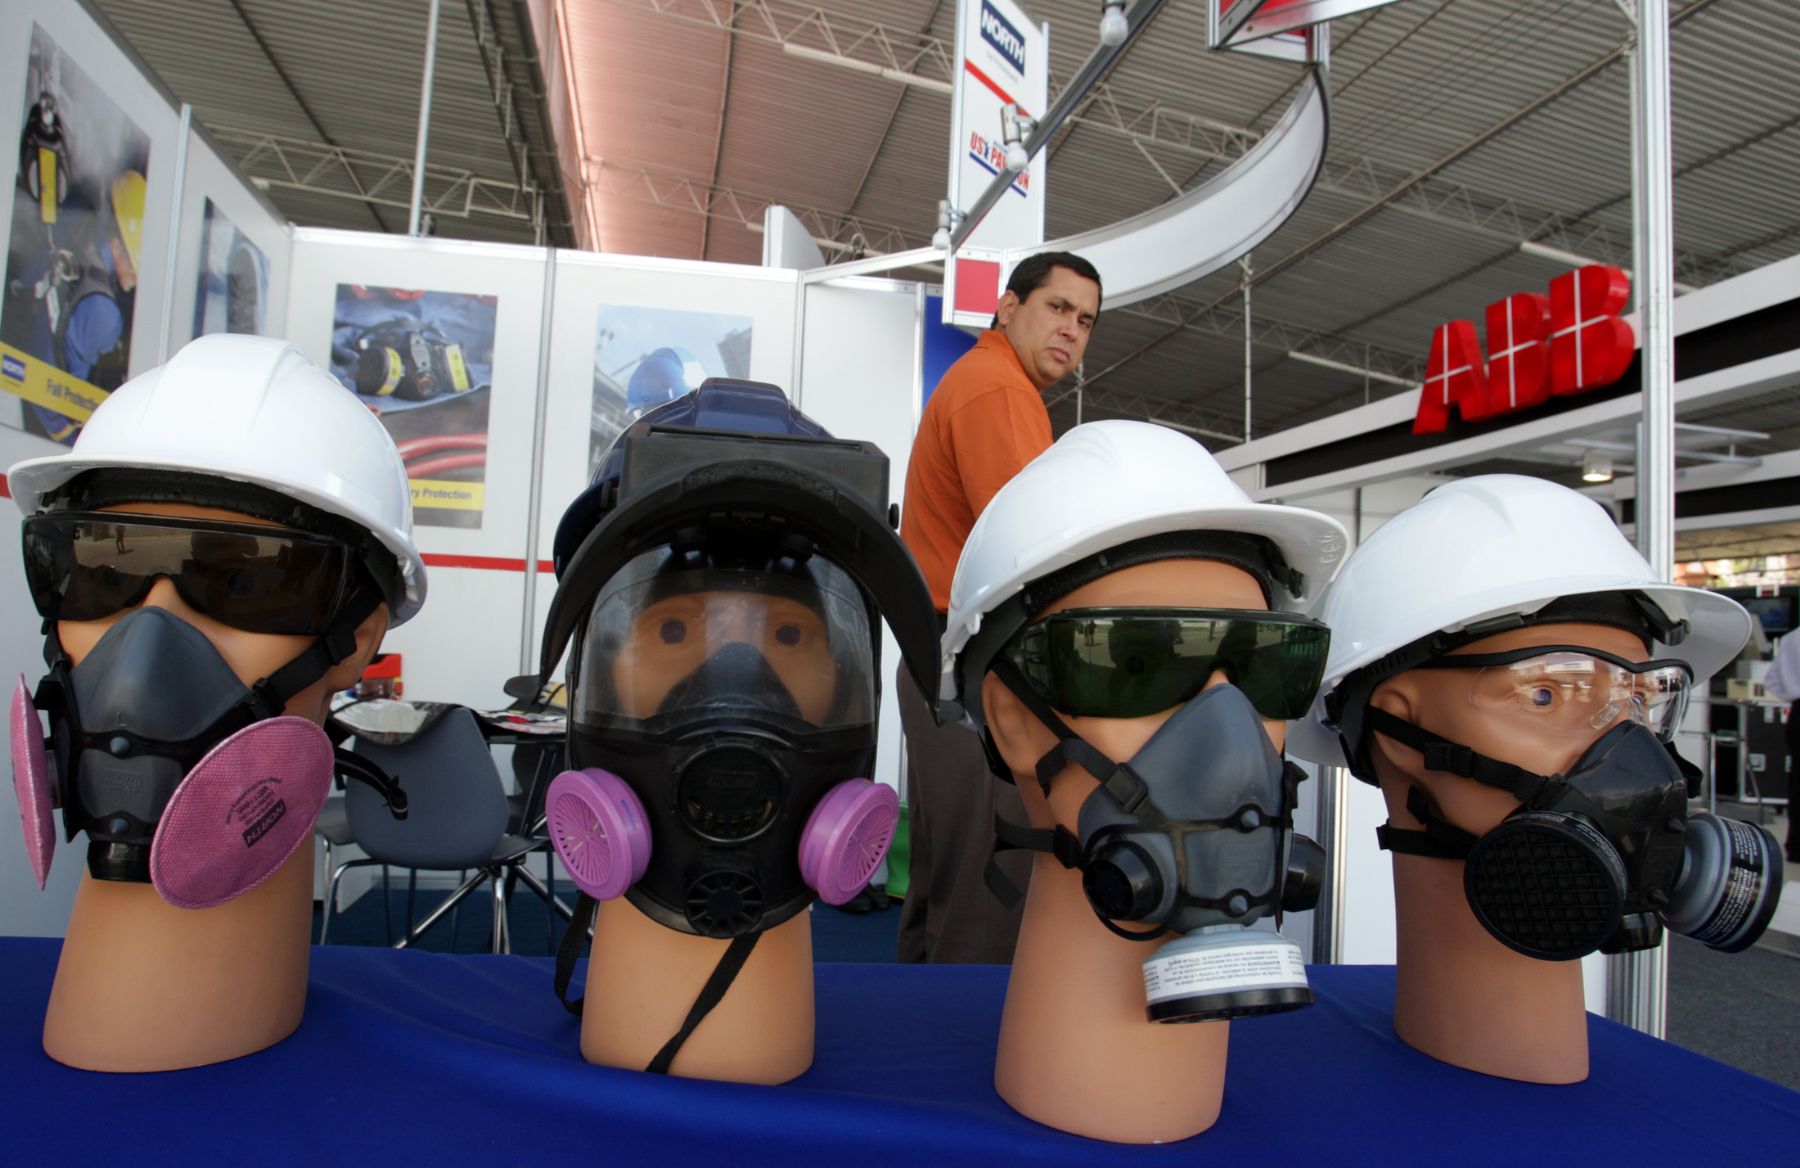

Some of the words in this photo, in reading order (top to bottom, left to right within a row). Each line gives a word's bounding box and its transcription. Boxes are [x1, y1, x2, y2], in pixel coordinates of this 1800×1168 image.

[982, 8, 1025, 65] NORTH
[1412, 265, 1636, 435] ABB
[46, 378, 63, 398] Fall
[422, 487, 472, 500] Protection
